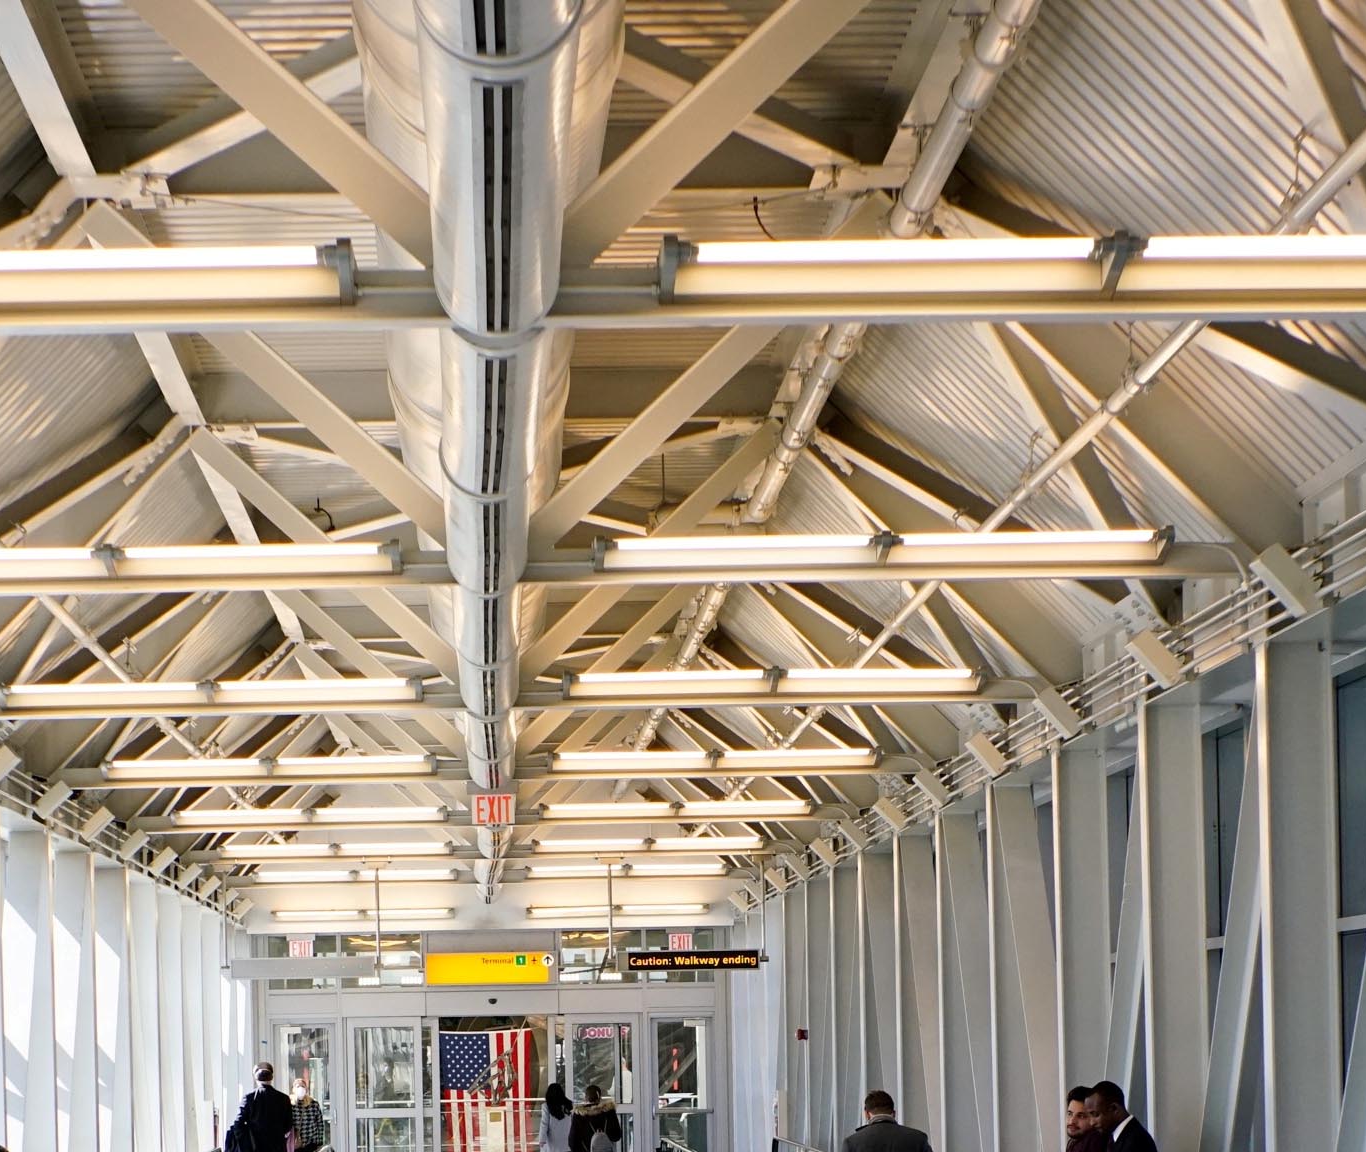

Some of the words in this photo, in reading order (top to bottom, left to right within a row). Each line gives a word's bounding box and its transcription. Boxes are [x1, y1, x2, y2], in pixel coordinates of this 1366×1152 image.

[476, 796, 511, 823] EXIT
[292, 941, 312, 957] EXIT
[671, 935, 691, 950] EXIT
[629, 956, 672, 966] Caution:
[674, 956, 720, 967] Walkway
[722, 955, 757, 966] ending
[578, 1026, 629, 1040] DONUS
